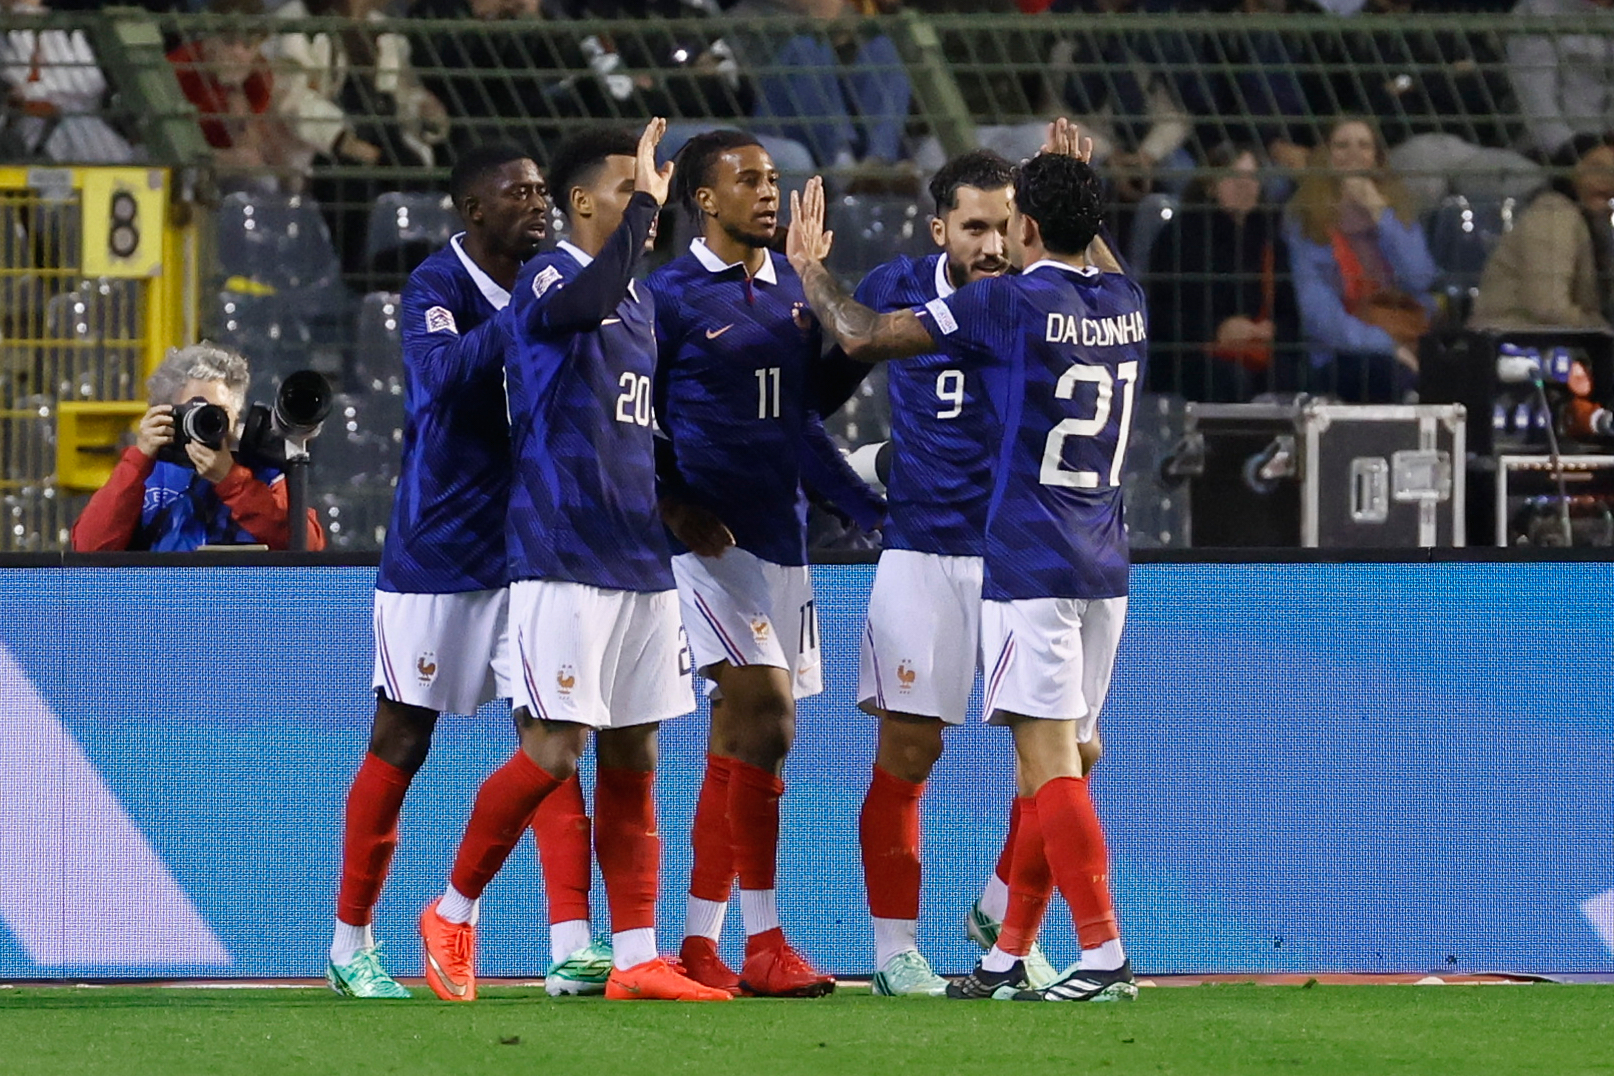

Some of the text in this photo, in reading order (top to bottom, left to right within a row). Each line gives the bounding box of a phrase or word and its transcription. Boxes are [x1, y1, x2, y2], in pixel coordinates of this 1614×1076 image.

[110, 190, 139, 258] 8
[1046, 310, 1147, 347] DA CUNHA
[616, 371, 650, 427] 20
[755, 367, 780, 419] 11
[936, 369, 966, 419] 9
[1039, 360, 1138, 488] 21
[799, 600, 816, 654] 11
